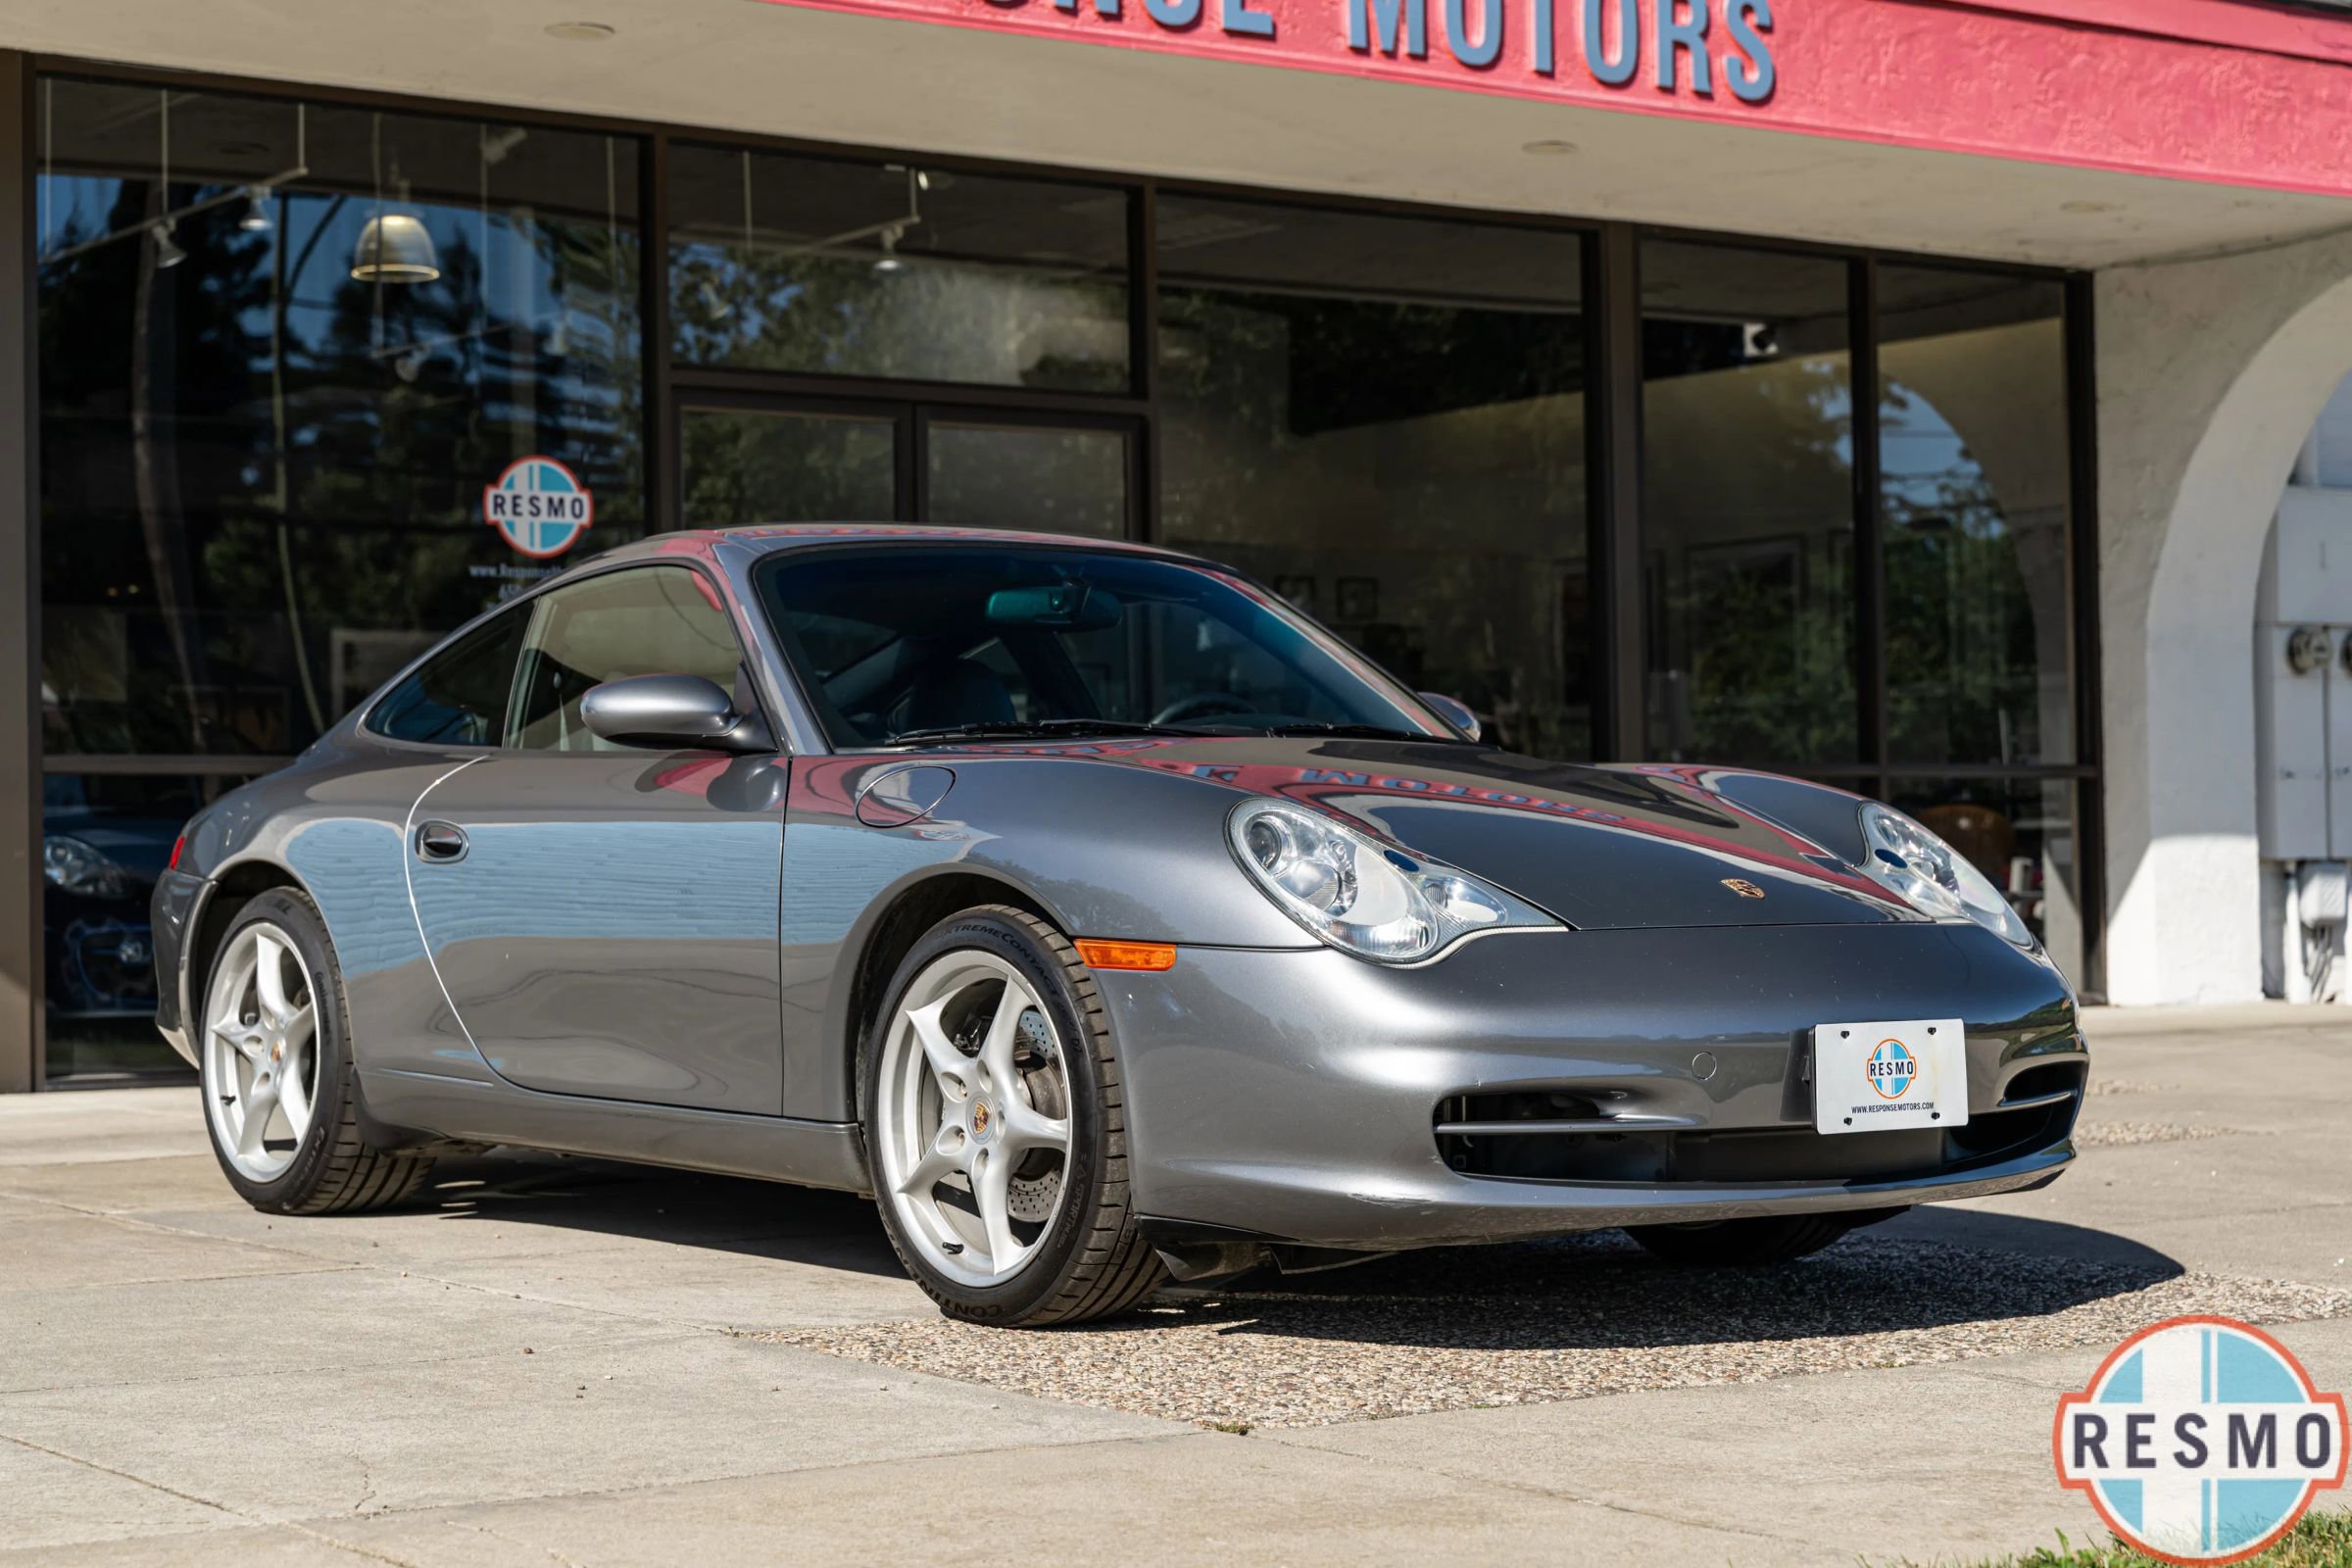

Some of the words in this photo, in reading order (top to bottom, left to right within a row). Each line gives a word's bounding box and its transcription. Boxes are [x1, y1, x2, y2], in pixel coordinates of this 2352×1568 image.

[493, 494, 584, 519] RESMO
[1870, 1060, 1914, 1077] RESMO
[1851, 1102, 1935, 1114] WWW.RESPONSEMOTORS.COM
